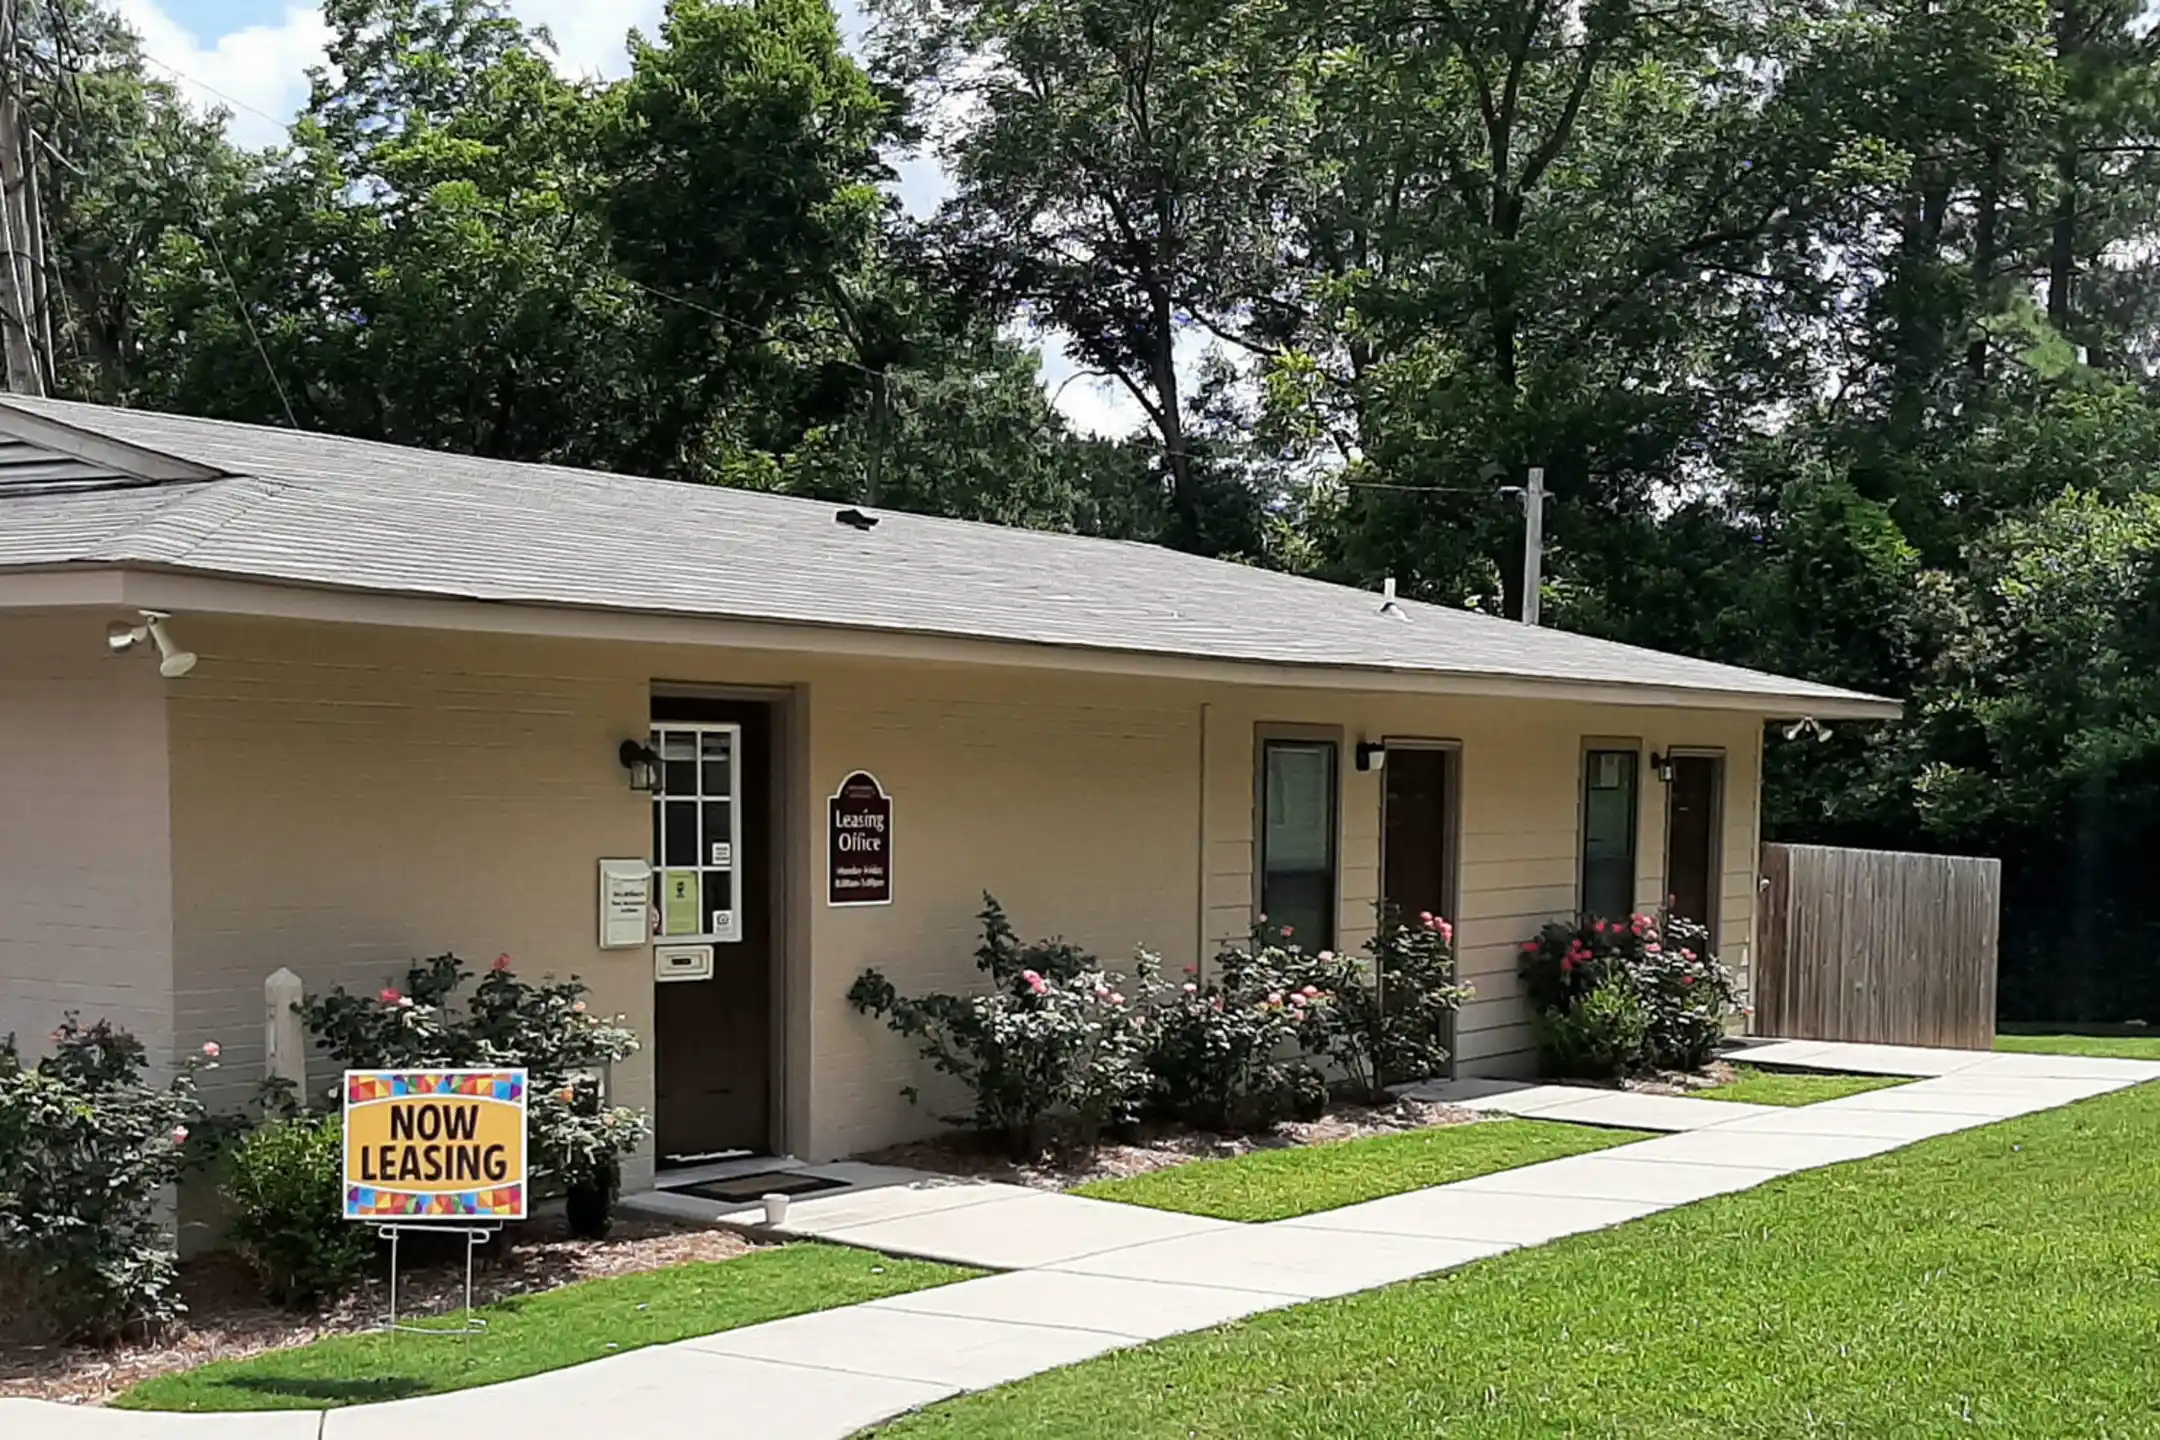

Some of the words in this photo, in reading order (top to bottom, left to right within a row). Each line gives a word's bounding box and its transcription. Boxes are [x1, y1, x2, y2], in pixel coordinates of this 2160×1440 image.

[835, 809, 885, 832] Leasing
[838, 832, 882, 852] Office
[390, 1104, 480, 1141] NOW
[361, 1144, 508, 1181] LEASING
